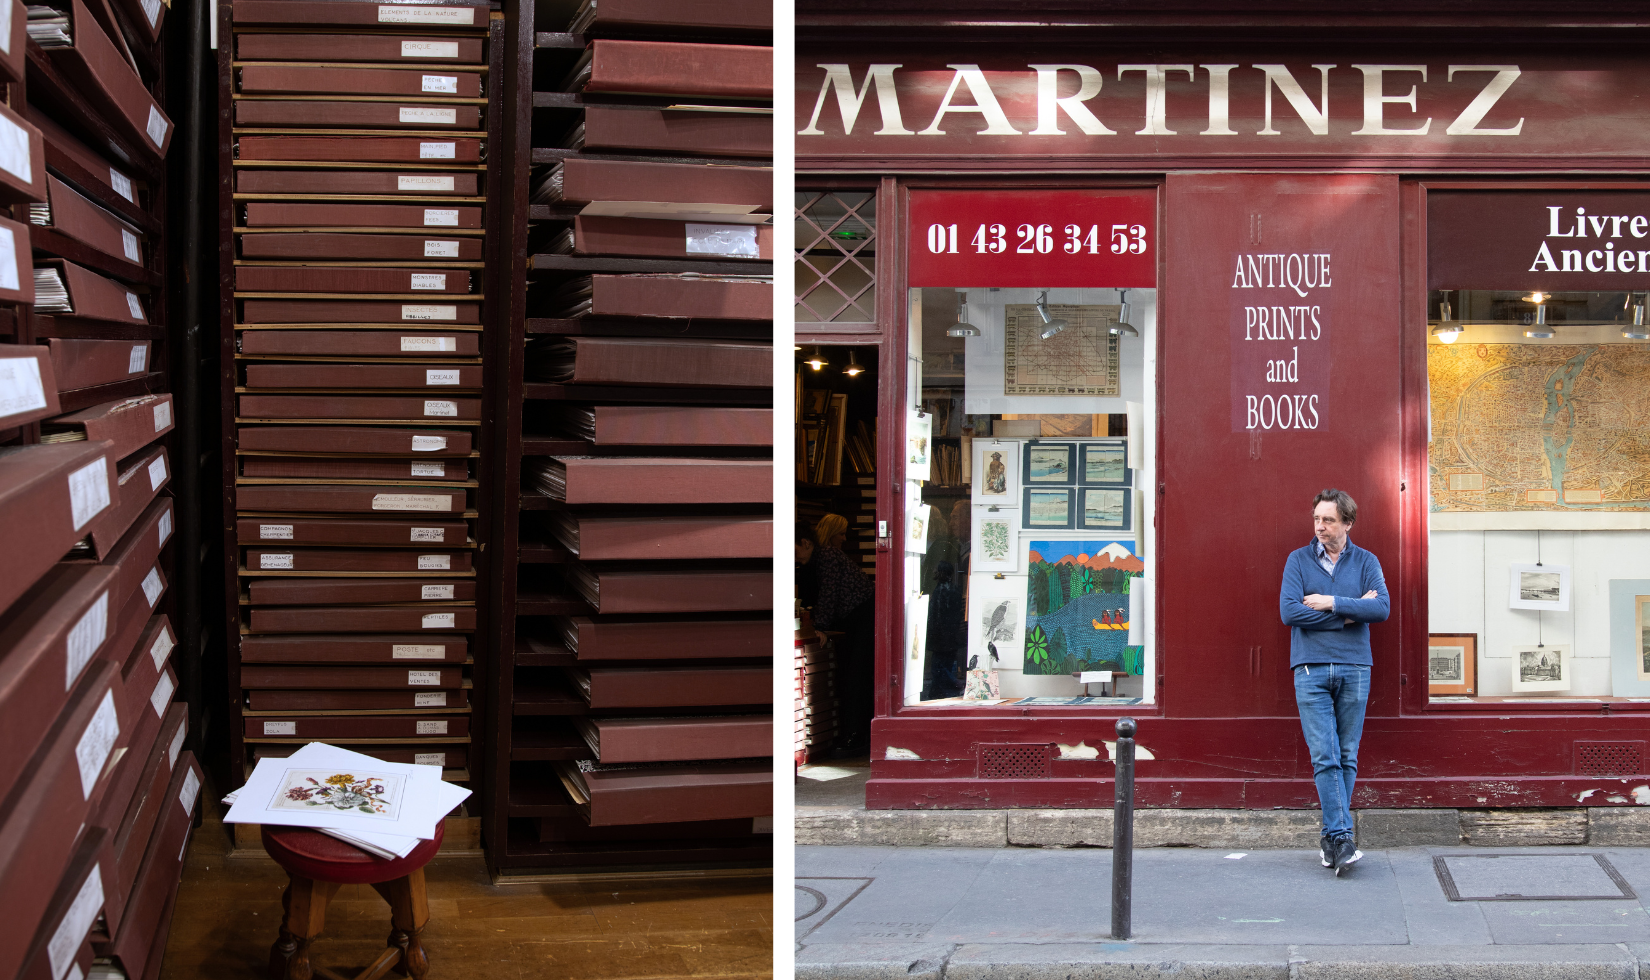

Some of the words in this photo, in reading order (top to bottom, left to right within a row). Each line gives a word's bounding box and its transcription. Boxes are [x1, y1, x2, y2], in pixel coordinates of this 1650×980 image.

[404, 43, 432, 51] CIRQUE
[797, 63, 1525, 136] MARTINEZ
[927, 223, 960, 254] 01
[971, 223, 1007, 254] 43
[1016, 223, 1054, 254] 26
[1064, 223, 1101, 255] 34
[1110, 223, 1147, 254] 53
[1231, 253, 1332, 298] ANTIQUE
[1244, 305, 1321, 341] PRINTS
[1266, 346, 1299, 383] and
[1245, 394, 1319, 430] BOOKS
